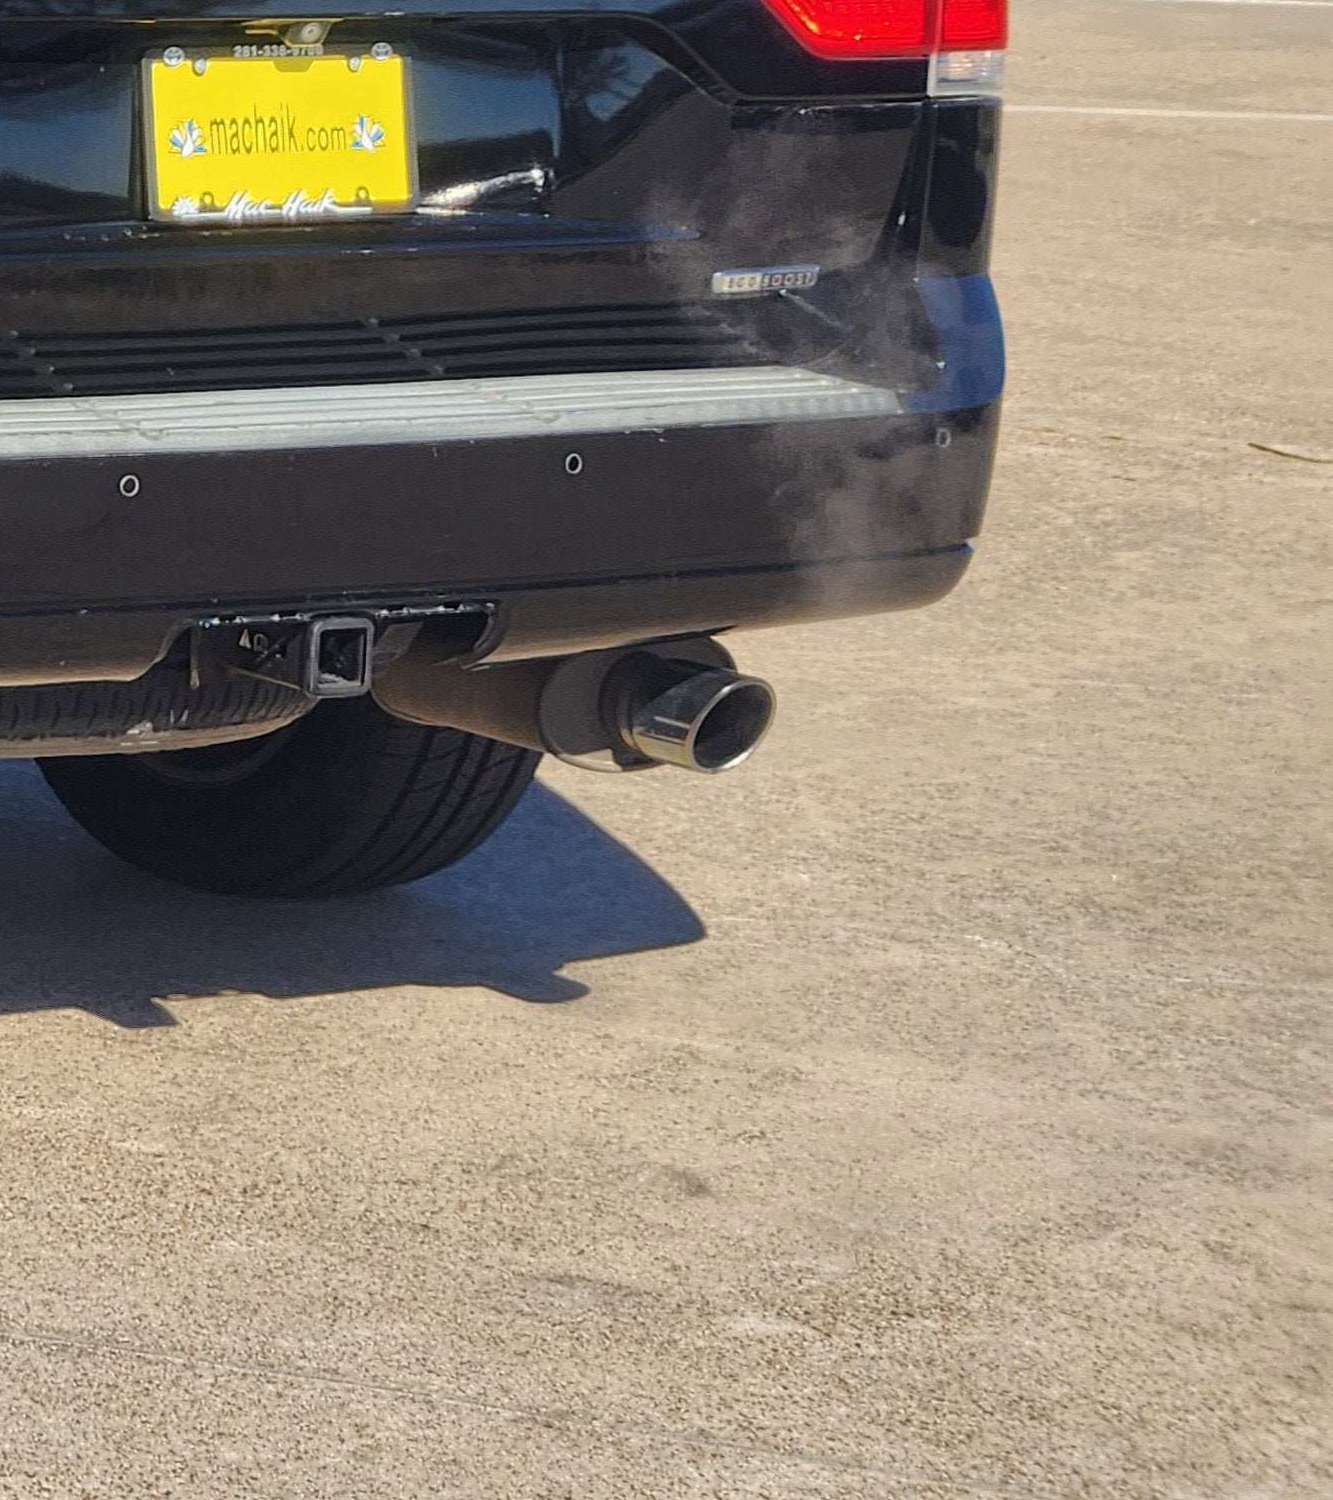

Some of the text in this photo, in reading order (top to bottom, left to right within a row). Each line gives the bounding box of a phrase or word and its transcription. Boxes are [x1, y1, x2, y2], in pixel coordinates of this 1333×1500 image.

[209, 102, 347, 155] machaik.com
[223, 187, 343, 220] Mac Haik
